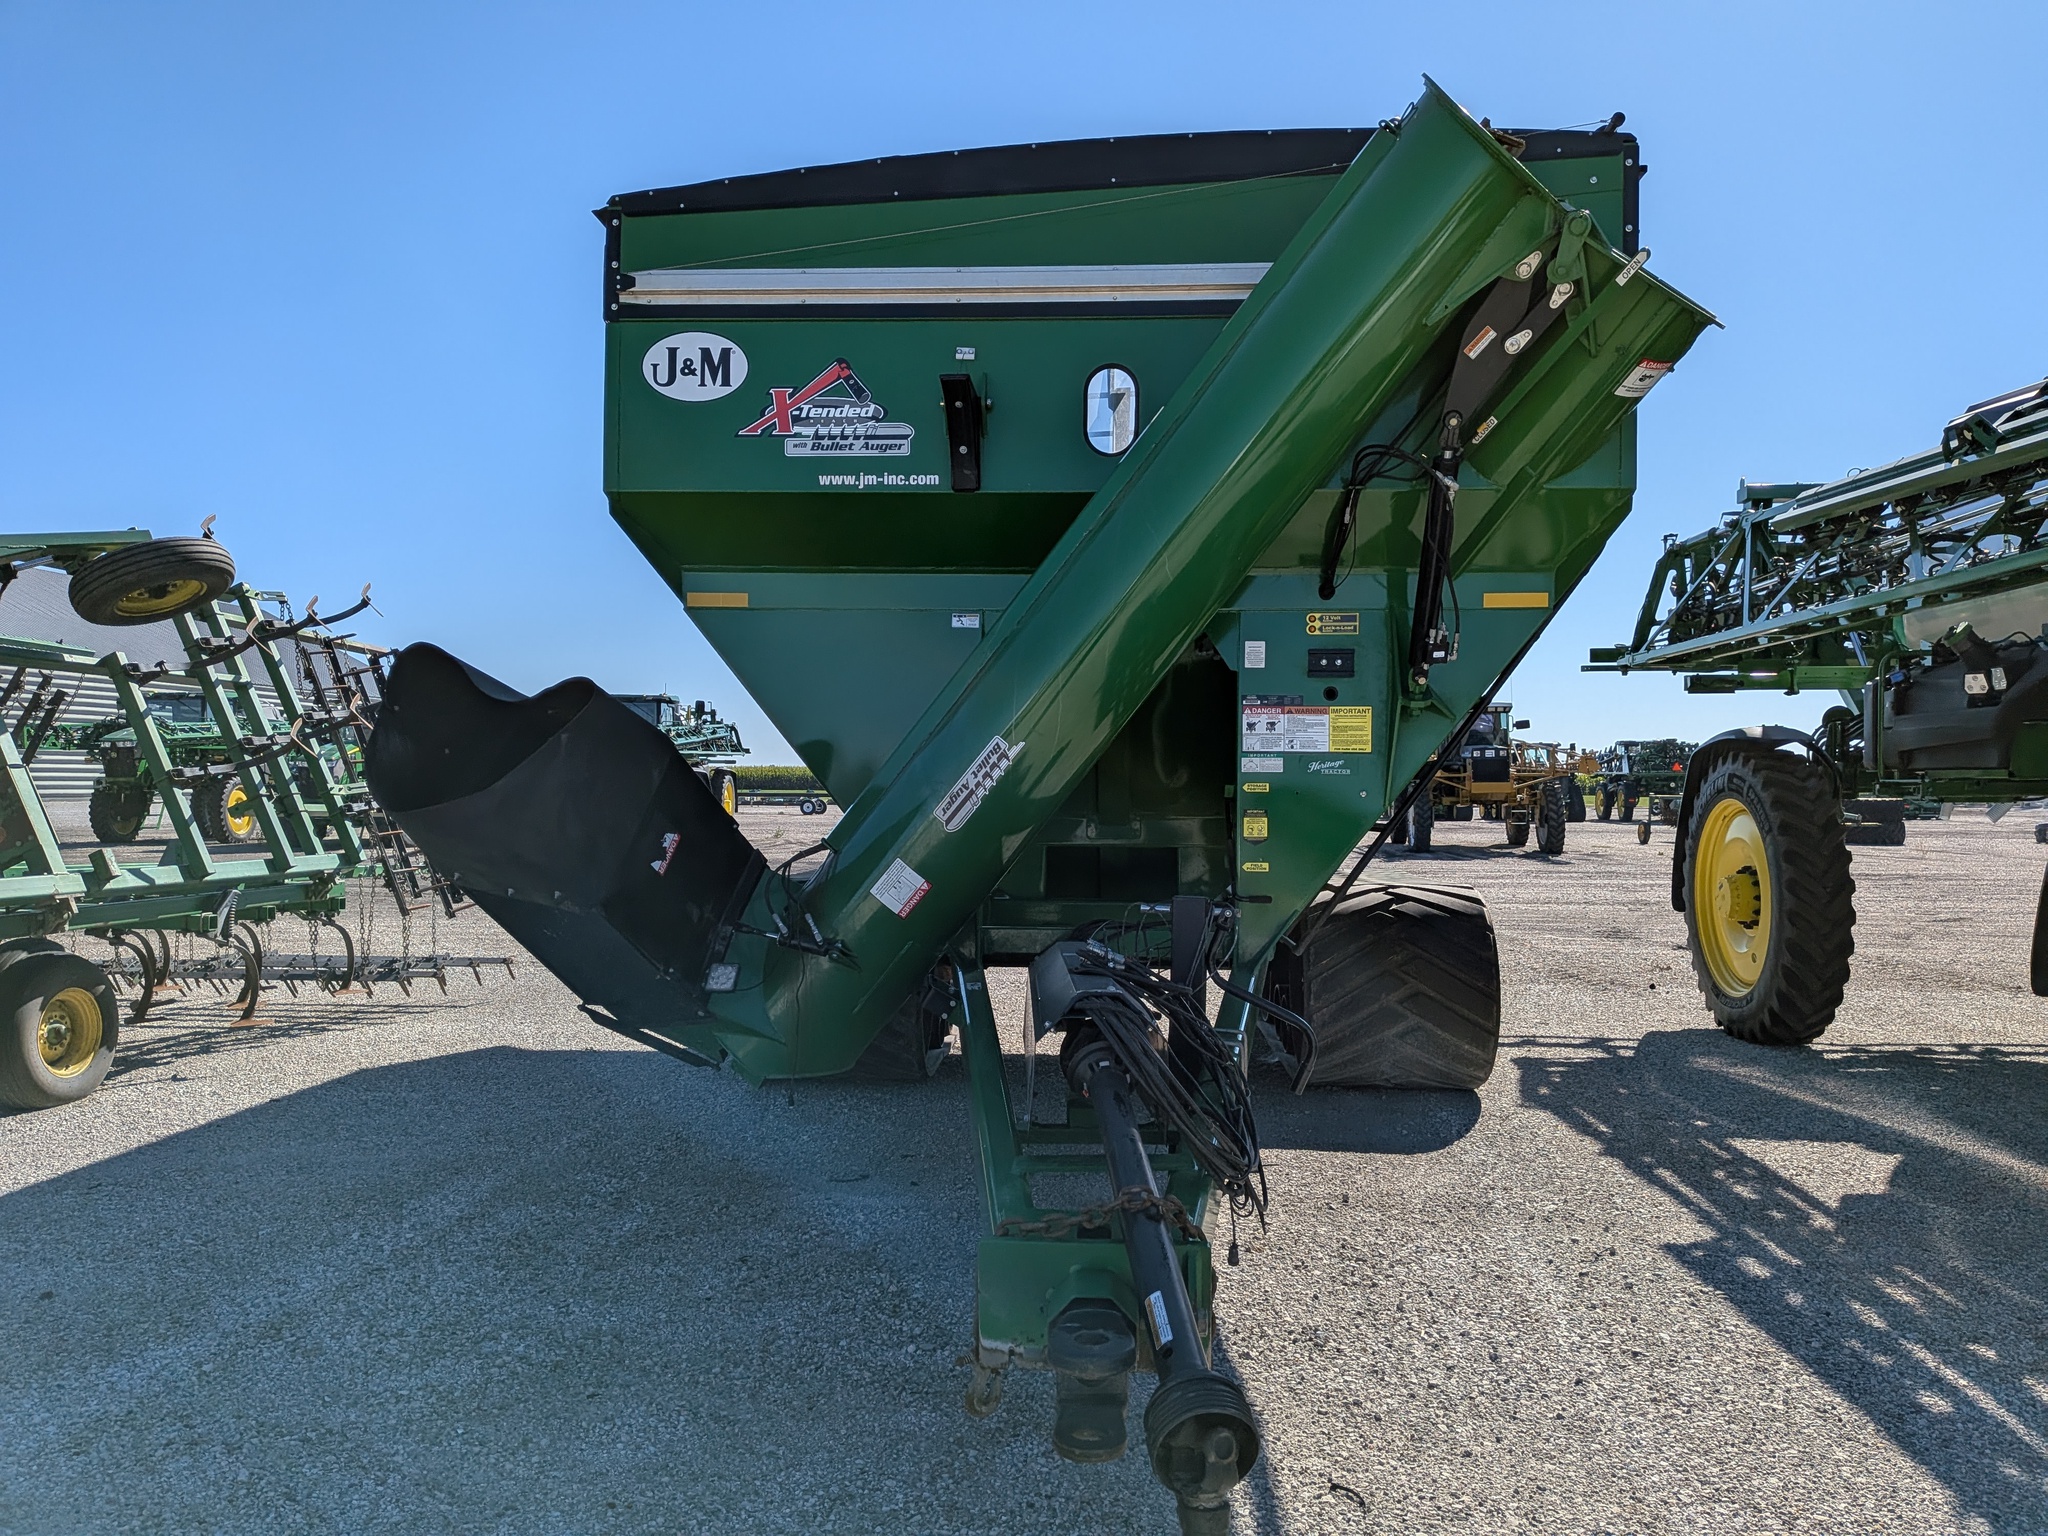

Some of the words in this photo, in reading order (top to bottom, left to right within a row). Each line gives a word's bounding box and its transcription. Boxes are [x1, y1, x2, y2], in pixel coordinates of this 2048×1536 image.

[1621, 258, 1642, 280] OPEN
[650, 346, 734, 389] J&M
[792, 441, 807, 450] with
[810, 440, 855, 452] Bullet
[857, 440, 906, 454] Auger
[818, 472, 940, 489] www.jm-inc.com
[972, 741, 1003, 780] Bullet
[1307, 760, 1345, 773] Heritage
[942, 778, 971, 818] Auger
[899, 889, 925, 918] DANGER
